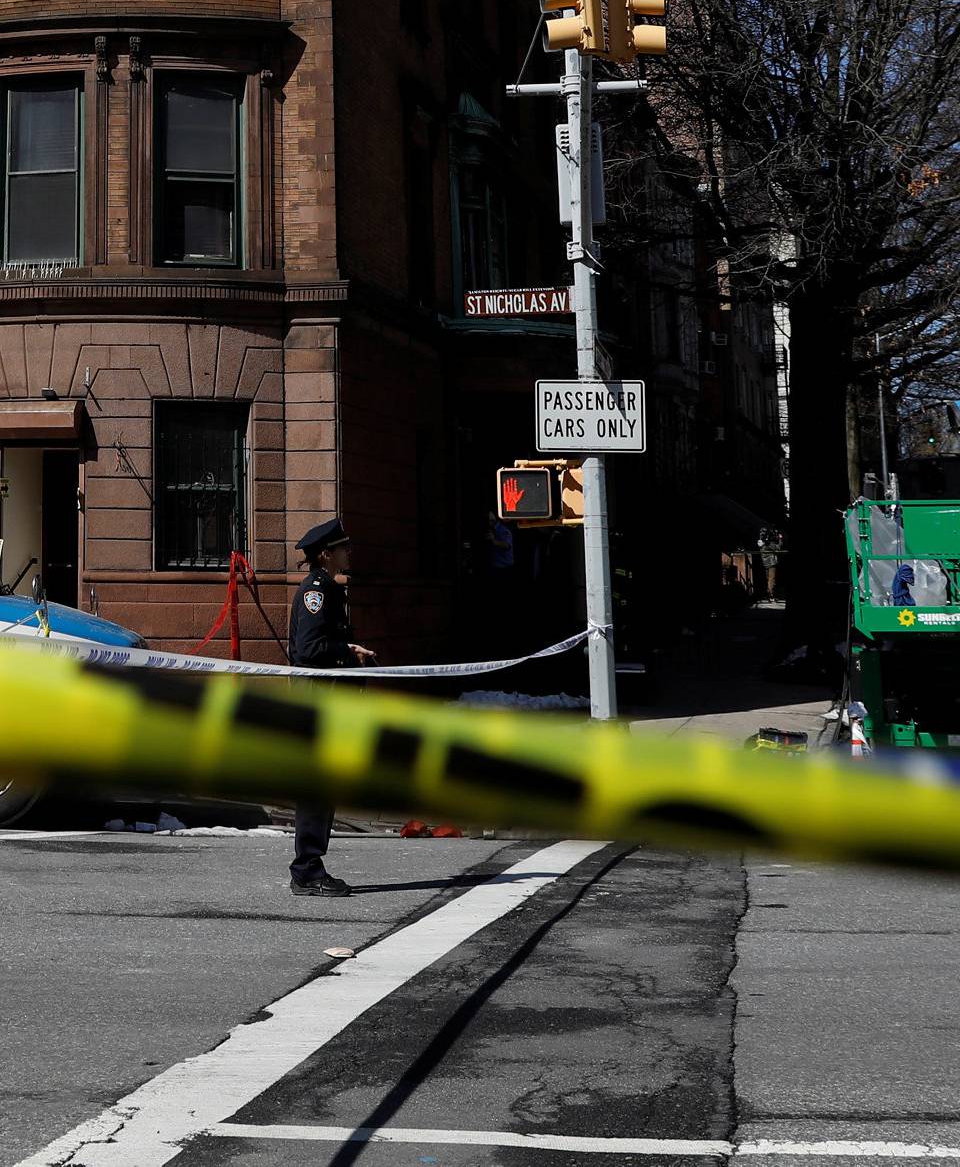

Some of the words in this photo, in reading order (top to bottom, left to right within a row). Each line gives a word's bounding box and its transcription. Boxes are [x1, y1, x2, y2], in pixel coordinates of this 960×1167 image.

[467, 295, 482, 315] ST
[485, 292, 547, 314] NICHOLAS
[551, 292, 567, 312] AV
[544, 391, 636, 411] PASSENGER
[544, 418, 585, 438] CARS
[597, 418, 637, 438] ONLY
